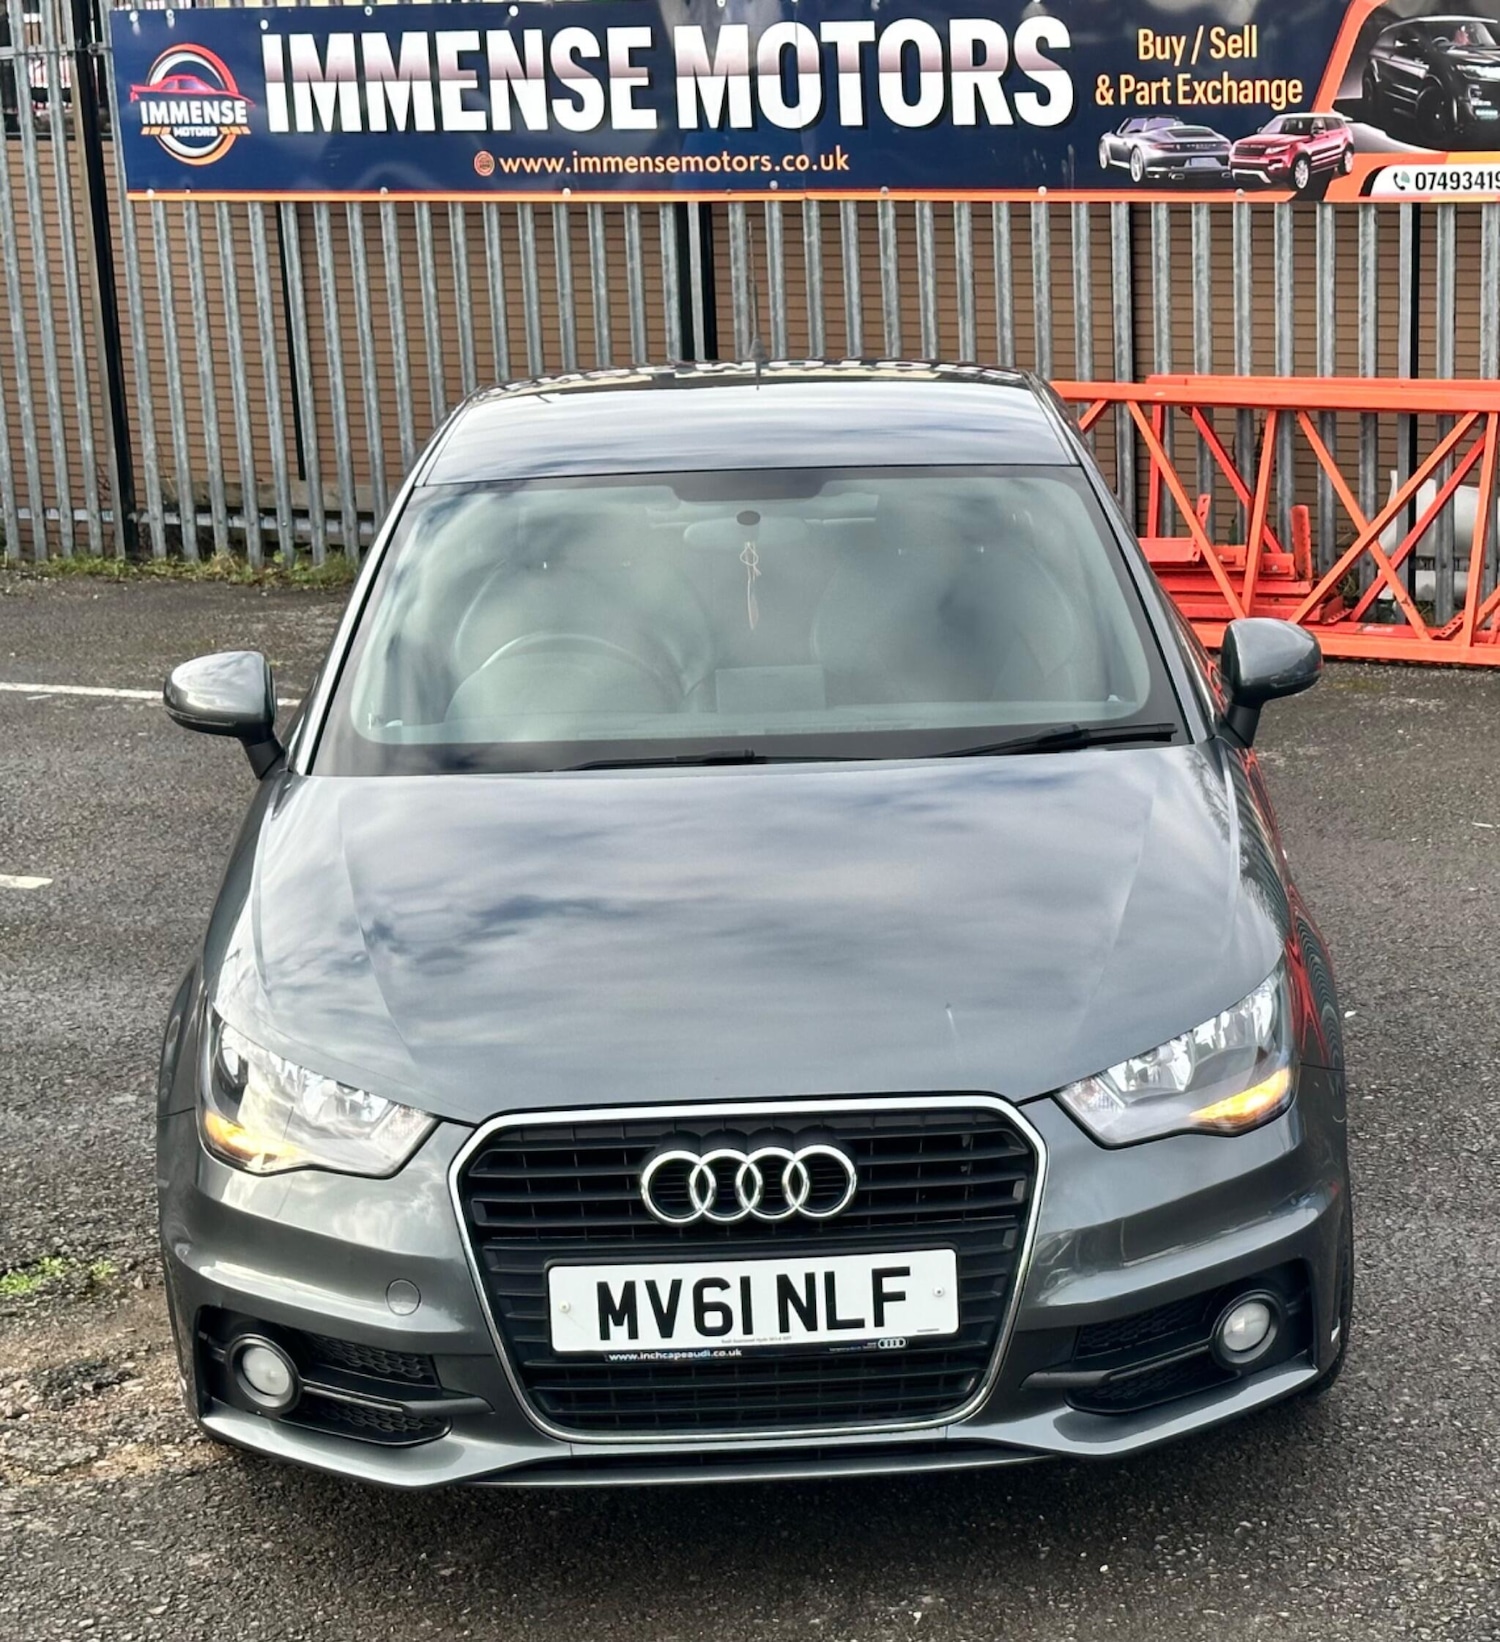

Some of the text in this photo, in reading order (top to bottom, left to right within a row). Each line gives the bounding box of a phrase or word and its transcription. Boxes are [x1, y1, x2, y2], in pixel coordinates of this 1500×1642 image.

[1137, 25, 1258, 66] Buy / Sell
[261, 15, 1074, 133] IMMENSE MOTORS
[1095, 71, 1304, 109] & Part Exchange
[140, 100, 248, 124] IMMENSE
[172, 126, 218, 137] MOTORS
[499, 145, 850, 174] www.immensemotors.co.uk
[596, 1266, 912, 1341] MV61 NLF
[608, 1348, 743, 1362] www.inchcapeaudi.co.uk
